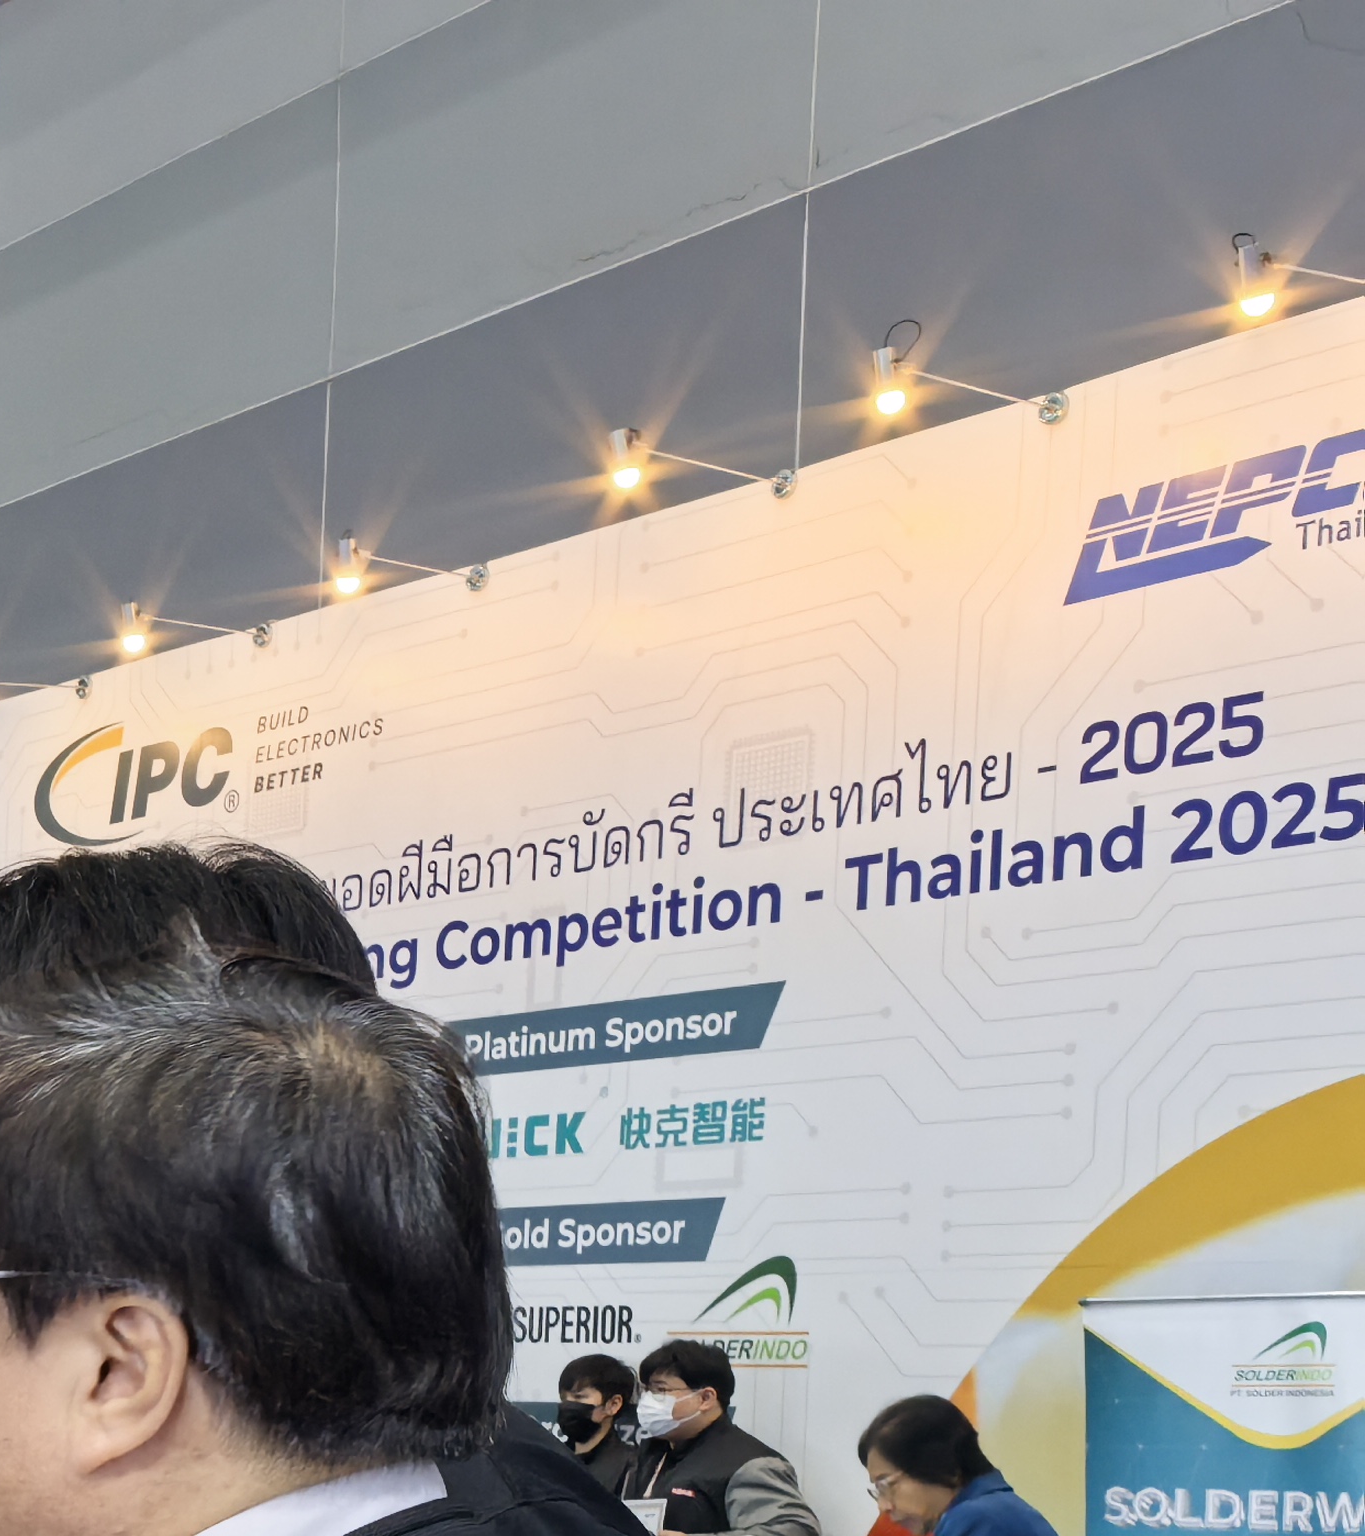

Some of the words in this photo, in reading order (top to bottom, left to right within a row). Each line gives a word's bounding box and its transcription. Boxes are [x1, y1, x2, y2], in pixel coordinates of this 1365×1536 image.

[255, 718, 384, 764] ELECTRONICS
[256, 706, 309, 734] BUILD
[108, 726, 233, 825] IPC
[253, 763, 324, 793] BETTER
[713, 738, 1012, 849] ประเทศไทย
[1079, 691, 1265, 784] 2025
[435, 876, 782, 967] Competition
[845, 805, 1145, 911] Thailand
[1170, 772, 1365, 864] 2025
[465, 1024, 596, 1061] Platinum
[605, 1010, 738, 1054] Sponsor
[619, 1096, 767, 1151] 快克智能
[557, 1217, 686, 1255] Sponsor
[512, 1304, 634, 1344] SUPERIOR
[1234, 1368, 1334, 1382] SOLDERINDO
[1245, 1388, 1284, 1398] SOLDER
